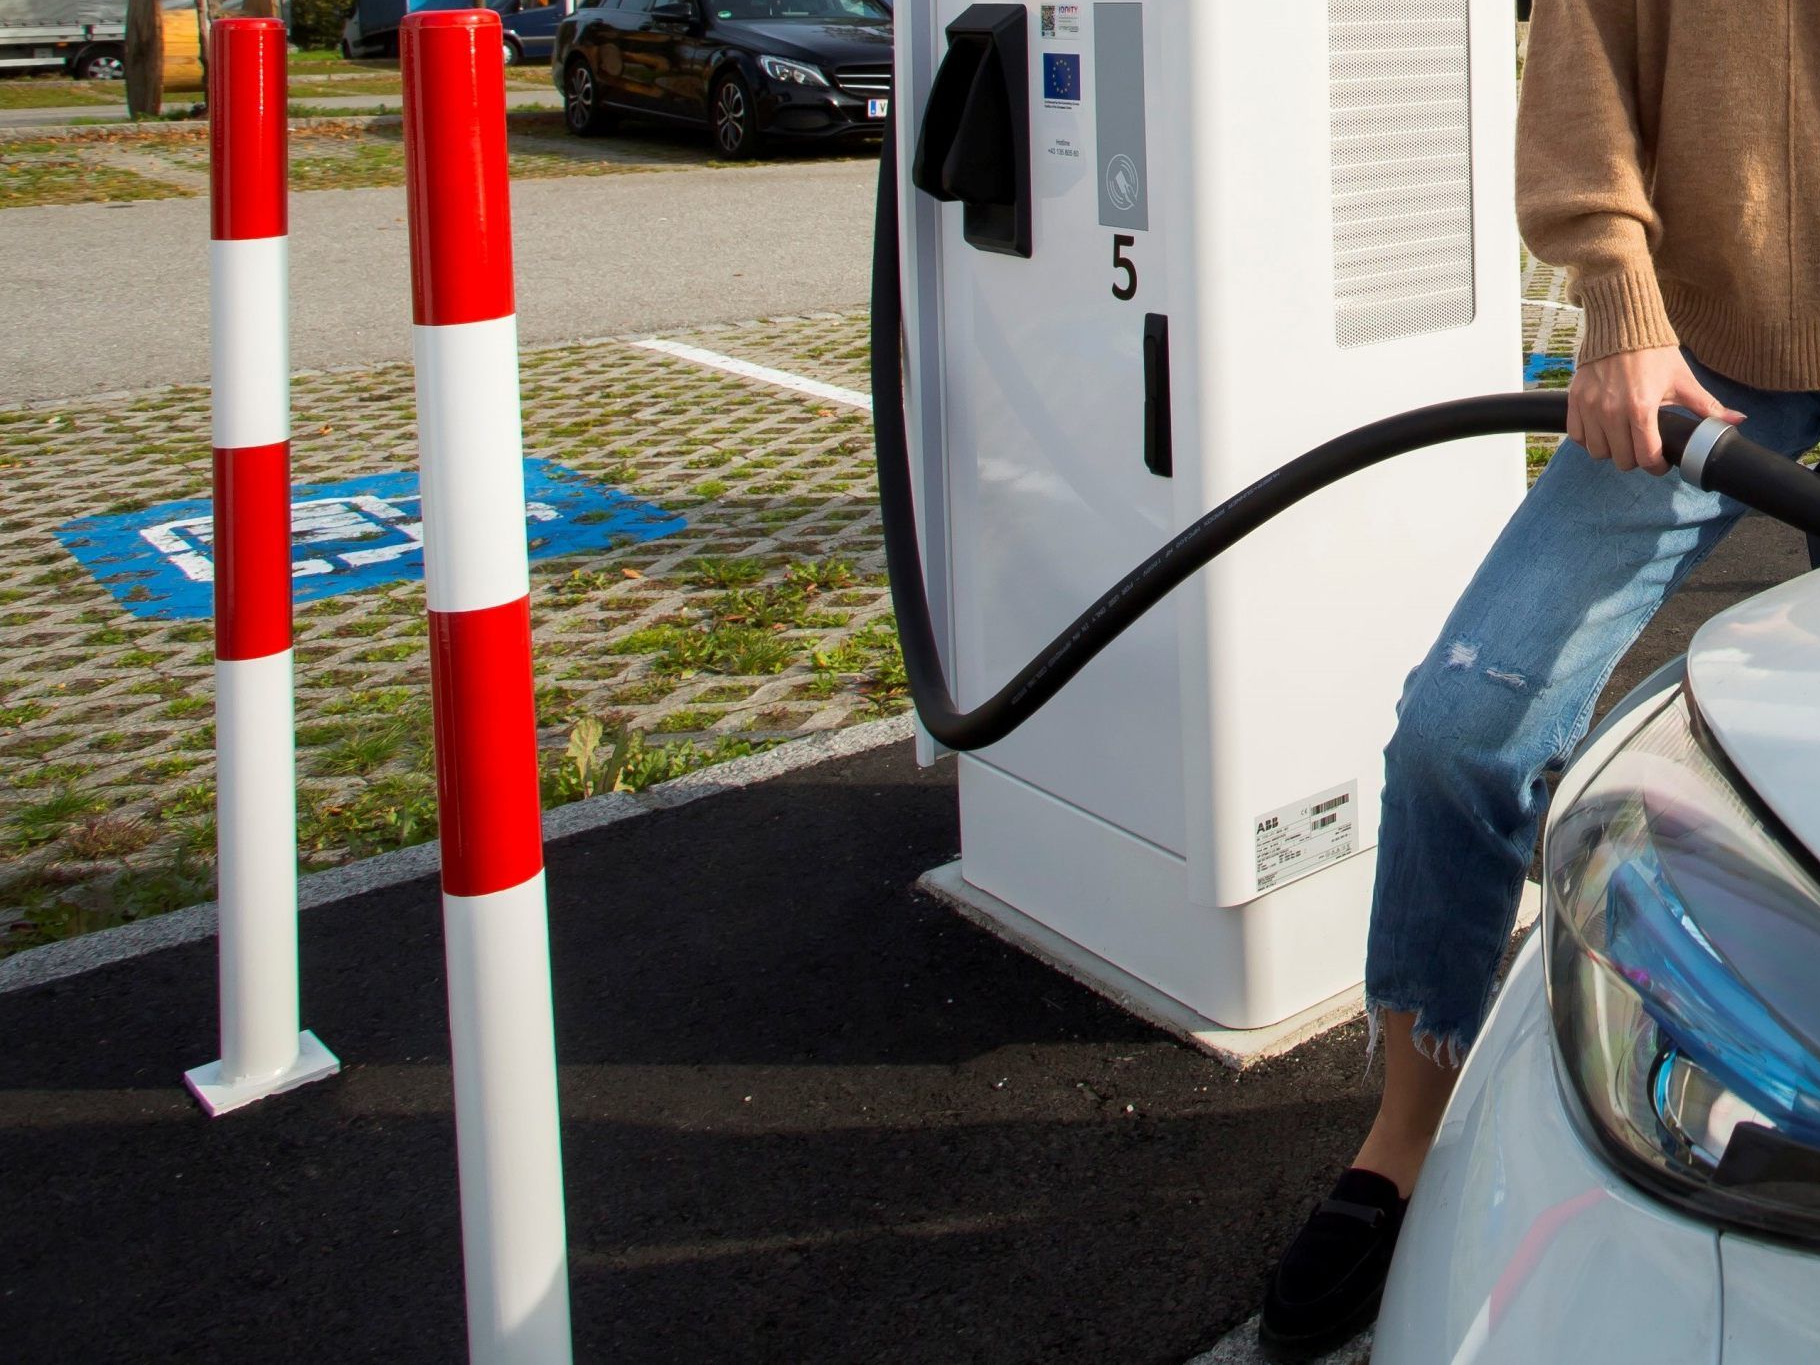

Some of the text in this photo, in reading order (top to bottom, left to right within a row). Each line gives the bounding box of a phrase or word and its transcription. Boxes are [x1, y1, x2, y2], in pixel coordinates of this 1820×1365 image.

[1058, 5, 1078, 14] IONITY
[1112, 234, 1138, 301] 5
[1256, 817, 1279, 835] ABB
